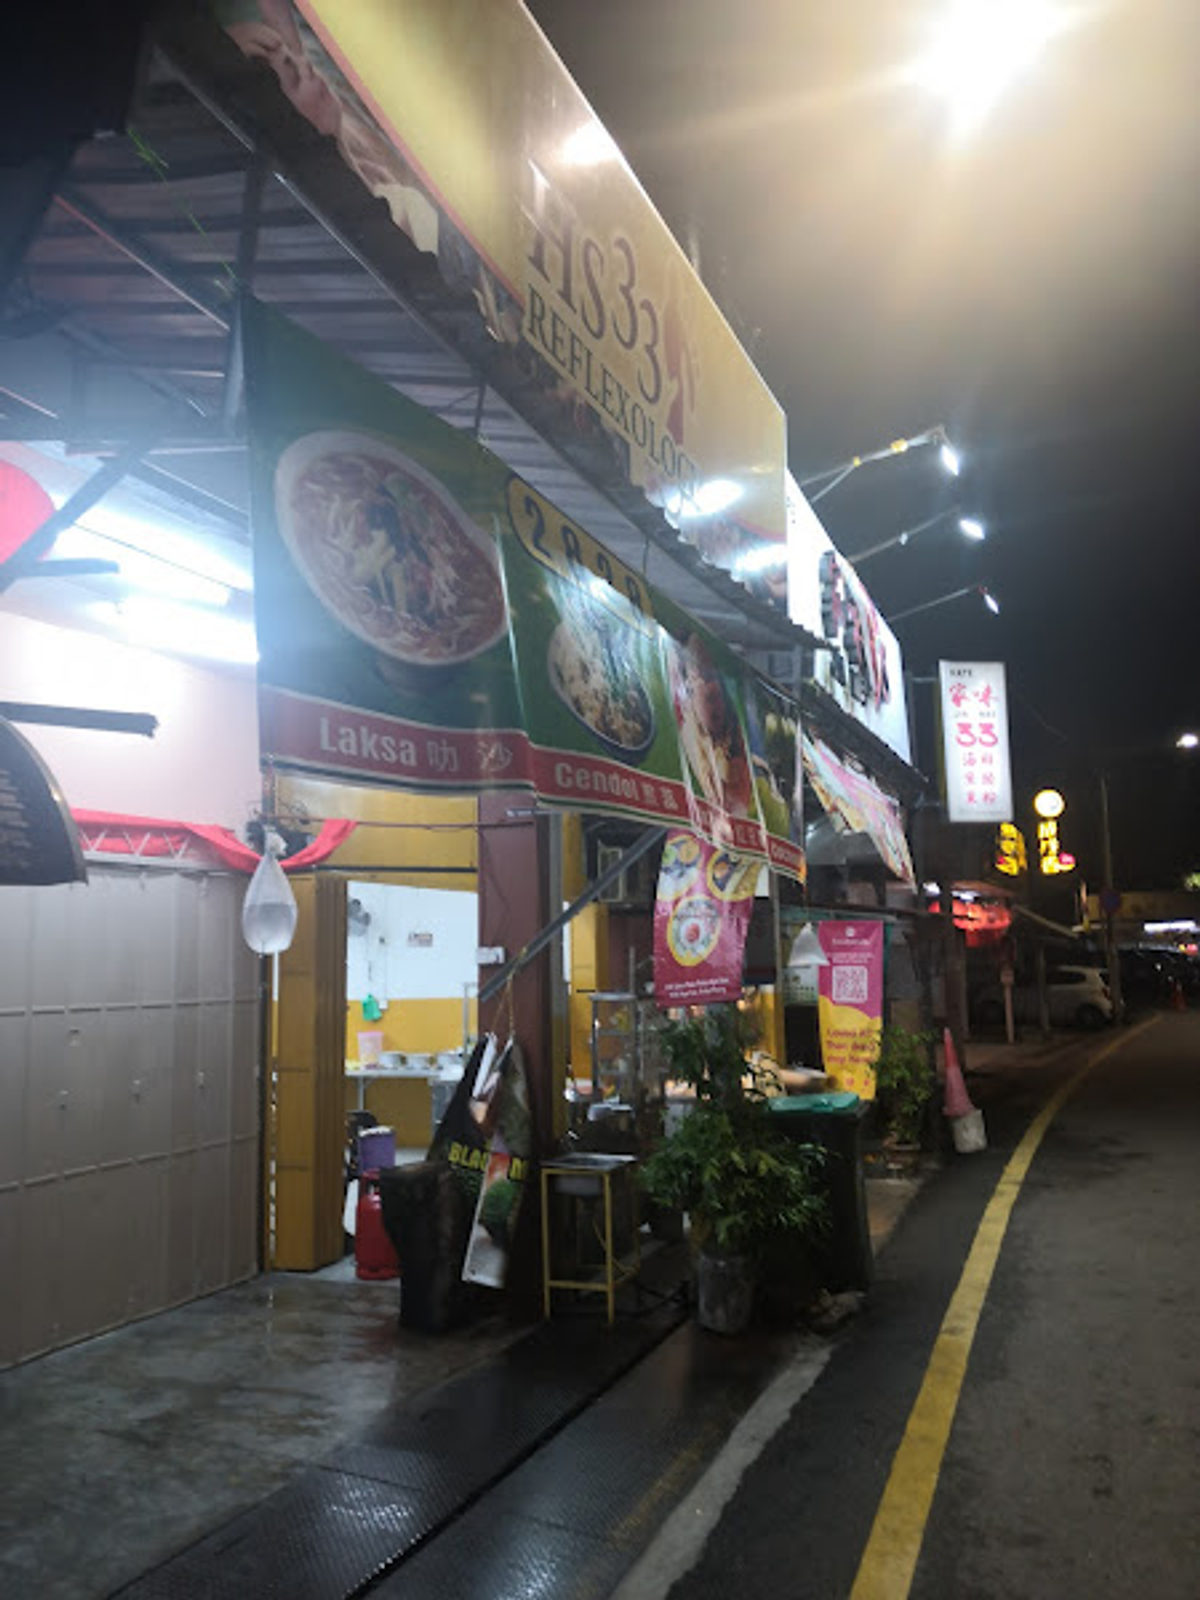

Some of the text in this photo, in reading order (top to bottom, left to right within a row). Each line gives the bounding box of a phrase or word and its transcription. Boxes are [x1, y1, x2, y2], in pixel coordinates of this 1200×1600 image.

[319, 716, 419, 768] Laksa
[956, 722, 998, 747] 33
[554, 761, 641, 803] Cendol
